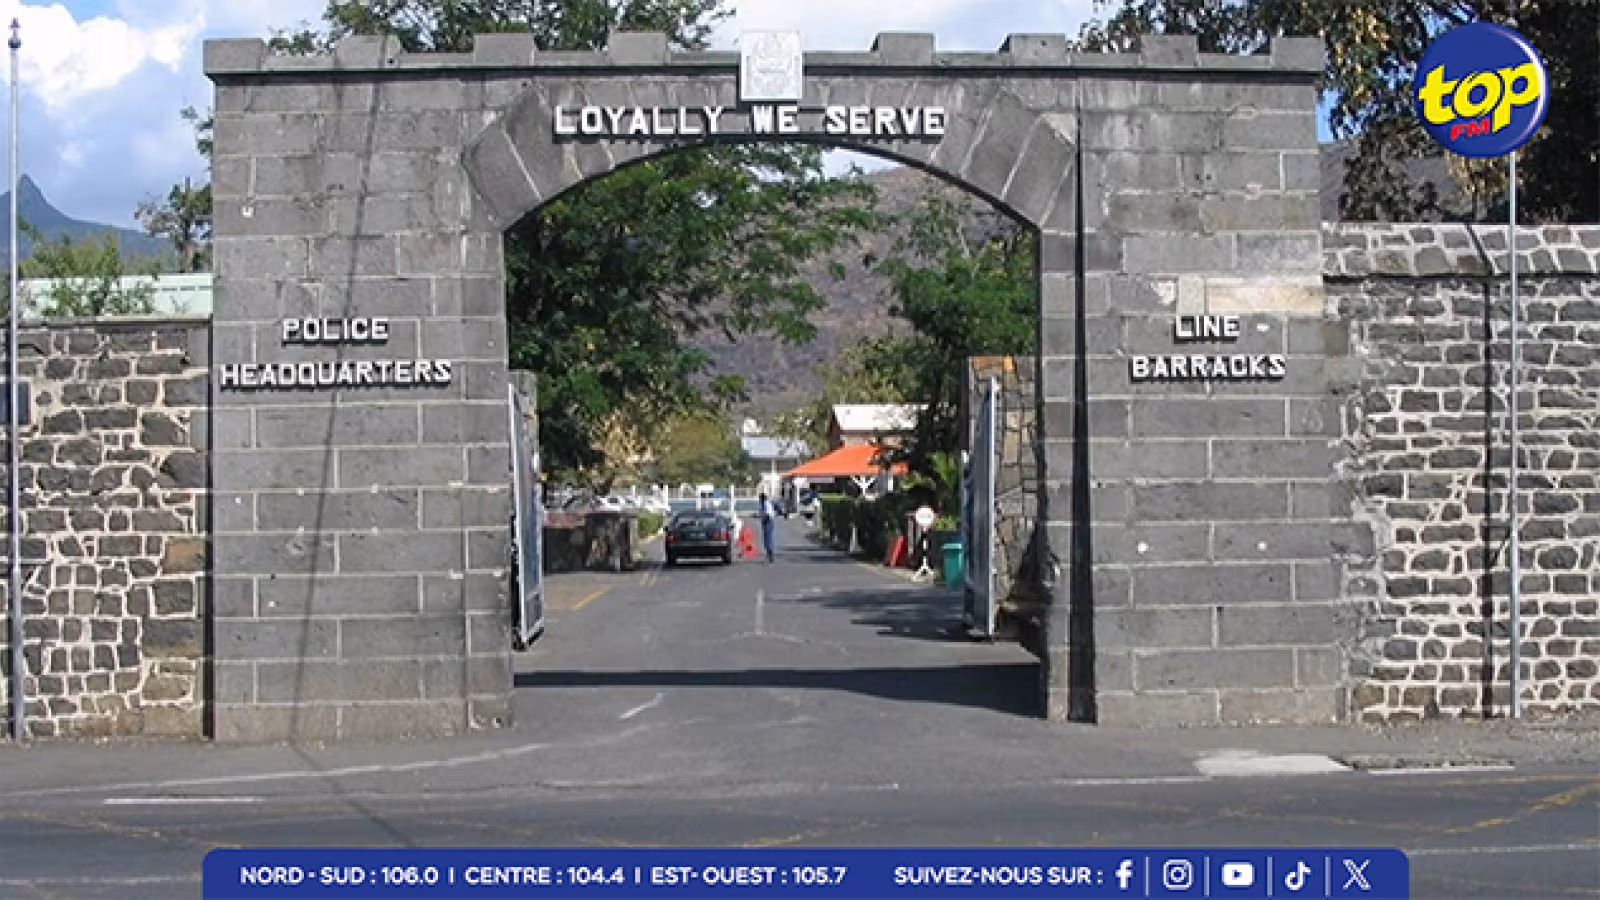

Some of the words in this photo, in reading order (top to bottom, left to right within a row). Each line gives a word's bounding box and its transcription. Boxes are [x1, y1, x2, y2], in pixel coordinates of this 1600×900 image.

[554, 105, 723, 135] LOYALLY
[752, 105, 798, 134] WE
[825, 105, 945, 135] SERVE
[282, 318, 389, 340] POLICE
[1175, 315, 1240, 337] LINE
[220, 359, 451, 386] HEADQUARTERS
[1132, 354, 1286, 378] BARRACKS
